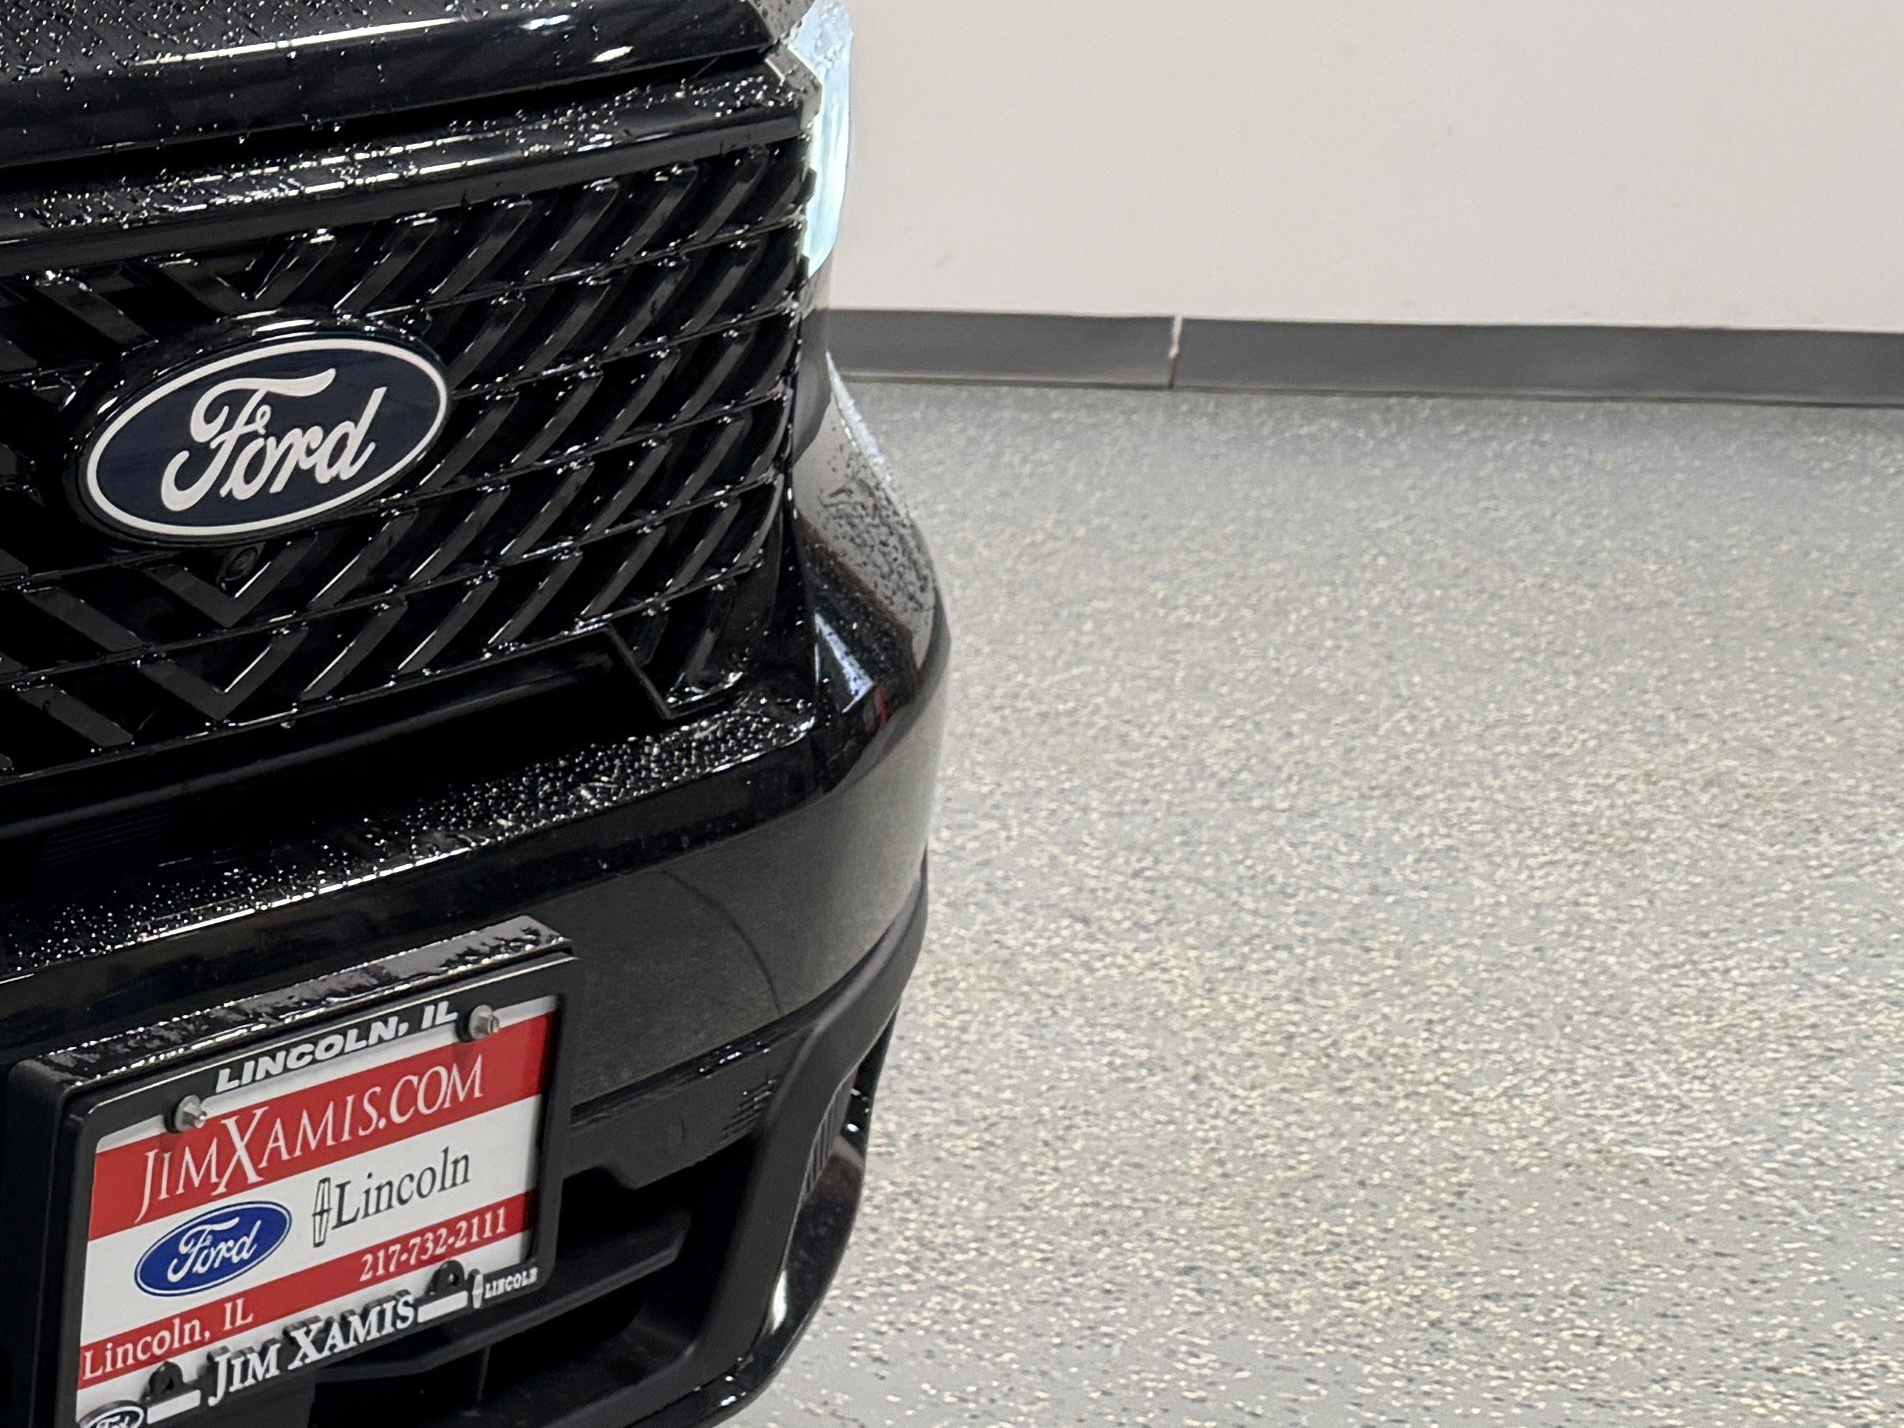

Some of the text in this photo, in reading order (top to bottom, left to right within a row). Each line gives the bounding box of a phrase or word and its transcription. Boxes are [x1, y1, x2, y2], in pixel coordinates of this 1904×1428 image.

[160, 368, 387, 512] Ford
[215, 1000, 458, 1093] LINCOLN, IL
[135, 1054, 483, 1224] JIMXAMIS.COM
[331, 1146, 470, 1230] Lincoln
[167, 1217, 262, 1283] Ford
[359, 1206, 507, 1282] 217-732-2111
[484, 1267, 539, 1299] LINCOLN
[82, 1298, 254, 1381] Lincoln, IL
[208, 1293, 415, 1406] JIM XAMIS
